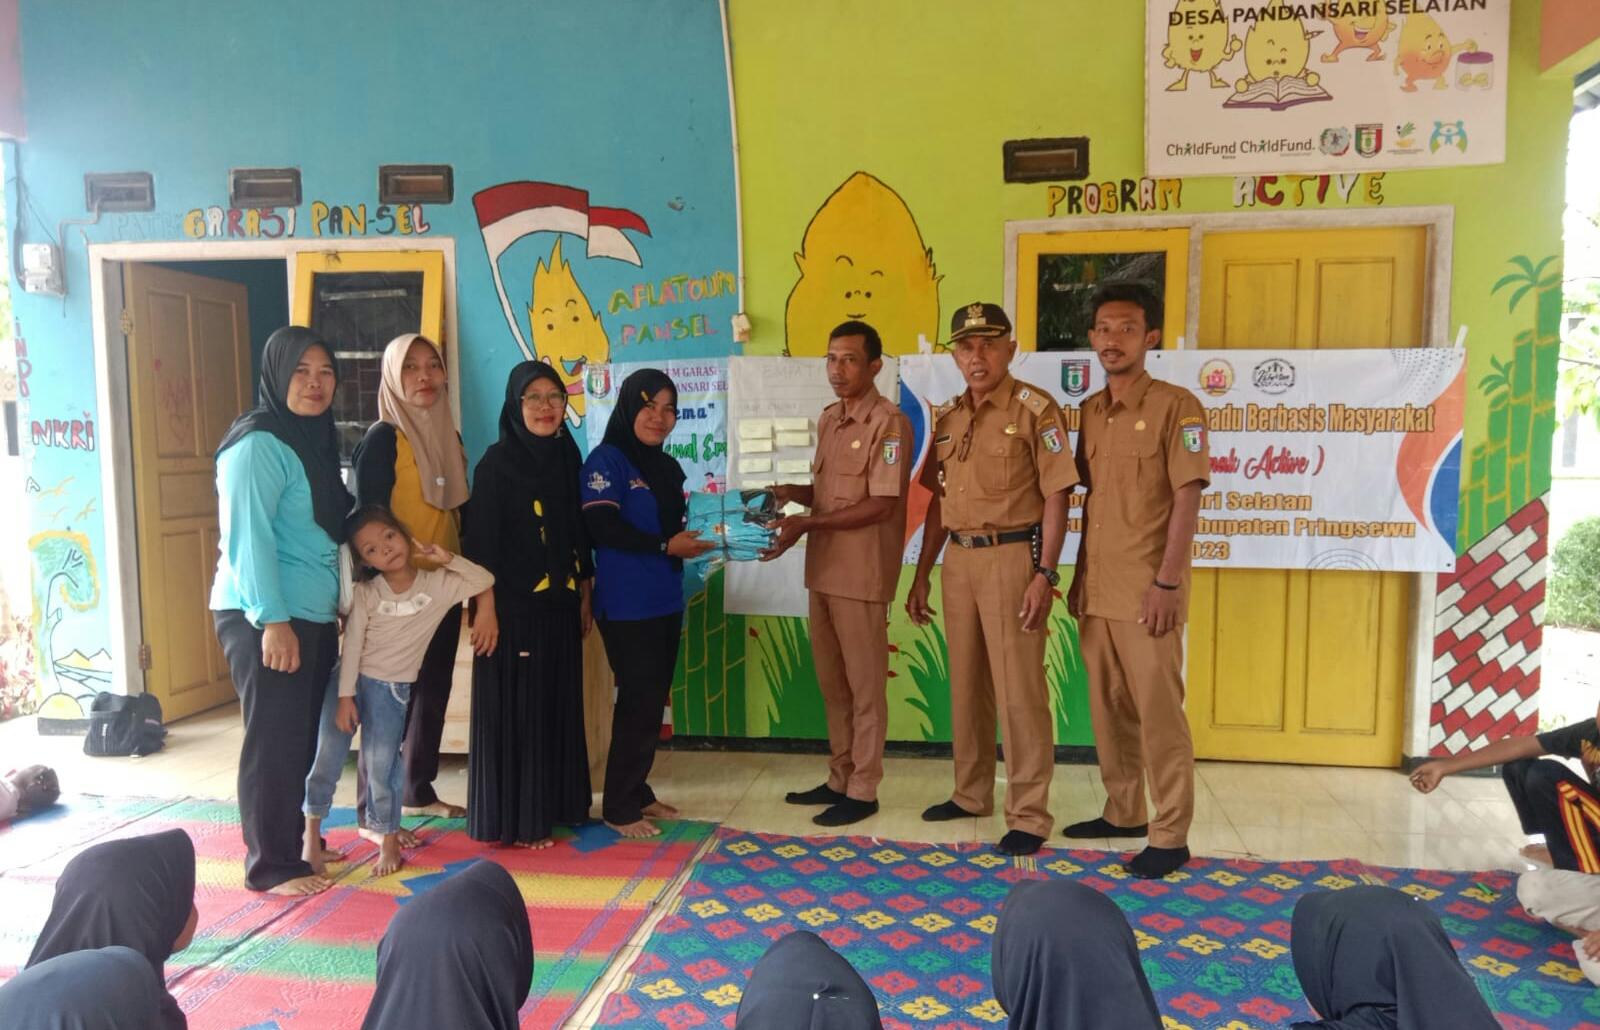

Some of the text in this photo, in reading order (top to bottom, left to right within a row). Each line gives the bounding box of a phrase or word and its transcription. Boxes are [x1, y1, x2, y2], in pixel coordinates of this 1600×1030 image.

[1168, 0, 1486, 26] DESA PANDANSARI SELATAN
[1048, 172, 1385, 217] PROGRAM ACTIVE
[183, 206, 296, 239] GARASI
[312, 201, 430, 236] PAN-SEL
[1246, 403, 1326, 433] Berbasis
[1328, 403, 1435, 435] Masyarakat
[1226, 491, 1313, 511] Selatan
[1195, 516, 1416, 539] bupaten Pringsewu
[1191, 541, 1230, 561] 023
